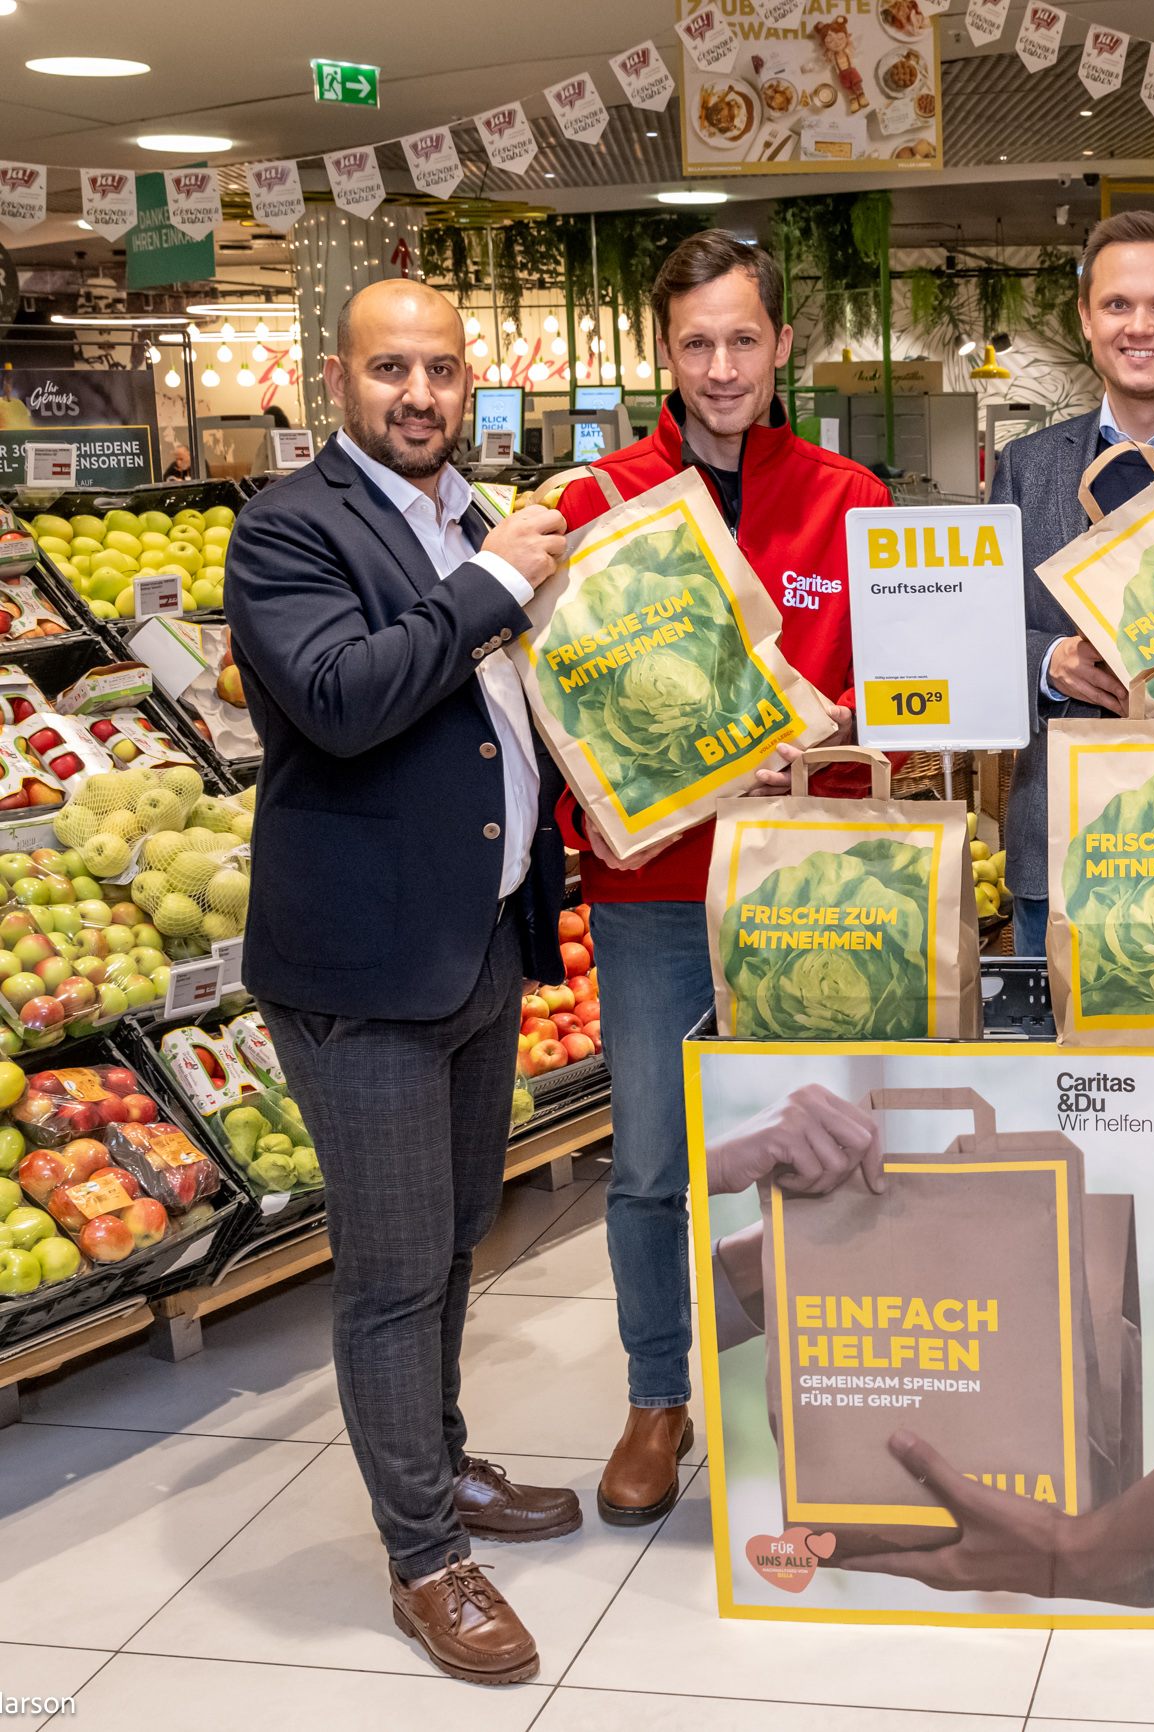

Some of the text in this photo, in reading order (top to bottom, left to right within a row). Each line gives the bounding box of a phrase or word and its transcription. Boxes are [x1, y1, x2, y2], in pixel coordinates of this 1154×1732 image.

[1020, 36, 1056, 55] GESUNDER
[1022, 46, 1048, 61] BODEN
[1082, 62, 1120, 80] GESUNDER
[1084, 73, 1113, 86] BODEN
[630, 75, 669, 98] GESUNDER
[640, 86, 668, 103] BODEN
[564, 108, 604, 130] GESUNDER
[573, 119, 601, 134] BODEN
[492, 140, 532, 157] GESUNDER
[501, 149, 529, 163] BODEN
[416, 164, 459, 180] GESUNDER
[426, 174, 455, 186] BODEN
[337, 184, 381, 199] GESUNDER
[346, 193, 376, 205] BODEN
[86, 208, 134, 216] GESUNDER
[173, 208, 219, 216] GESUNDER
[256, 200, 301, 211] GESUNDER
[264, 208, 296, 218] BODEN
[94, 216, 127, 225] BODEN
[180, 216, 213, 224] BODEN
[132, 231, 160, 252] IHREN
[44, 380, 58, 393] Ihr
[30, 387, 73, 409] Genuss
[75, 442, 140, 454] CHIEDENE
[76, 456, 144, 470] ENSORTEN
[868, 526, 1004, 569] BILLA
[782, 570, 842, 594] Caritas
[871, 582, 962, 595] Gruftsackerl
[782, 590, 820, 610] &Du
[546, 589, 695, 671] FRISCHE ZUM
[559, 617, 695, 694] MITNEHMEN
[694, 698, 784, 766] BILLA
[740, 904, 897, 926] FRISCHE ZUM
[738, 928, 882, 950] MITNEHMEN
[1056, 1072, 1136, 1094] Caritas
[1057, 1093, 1106, 1115] &Du
[1058, 1114, 1089, 1132] Wir
[796, 1296, 998, 1333] EINFACH
[797, 1334, 980, 1372] HELFEN
[800, 1374, 982, 1394] GEMEINSAM SPENDEN
[800, 1390, 923, 1410] FÜR DIE GRUFT
[770, 1541, 794, 1554] FÜR
[756, 1556, 812, 1568] UNS ALLE
